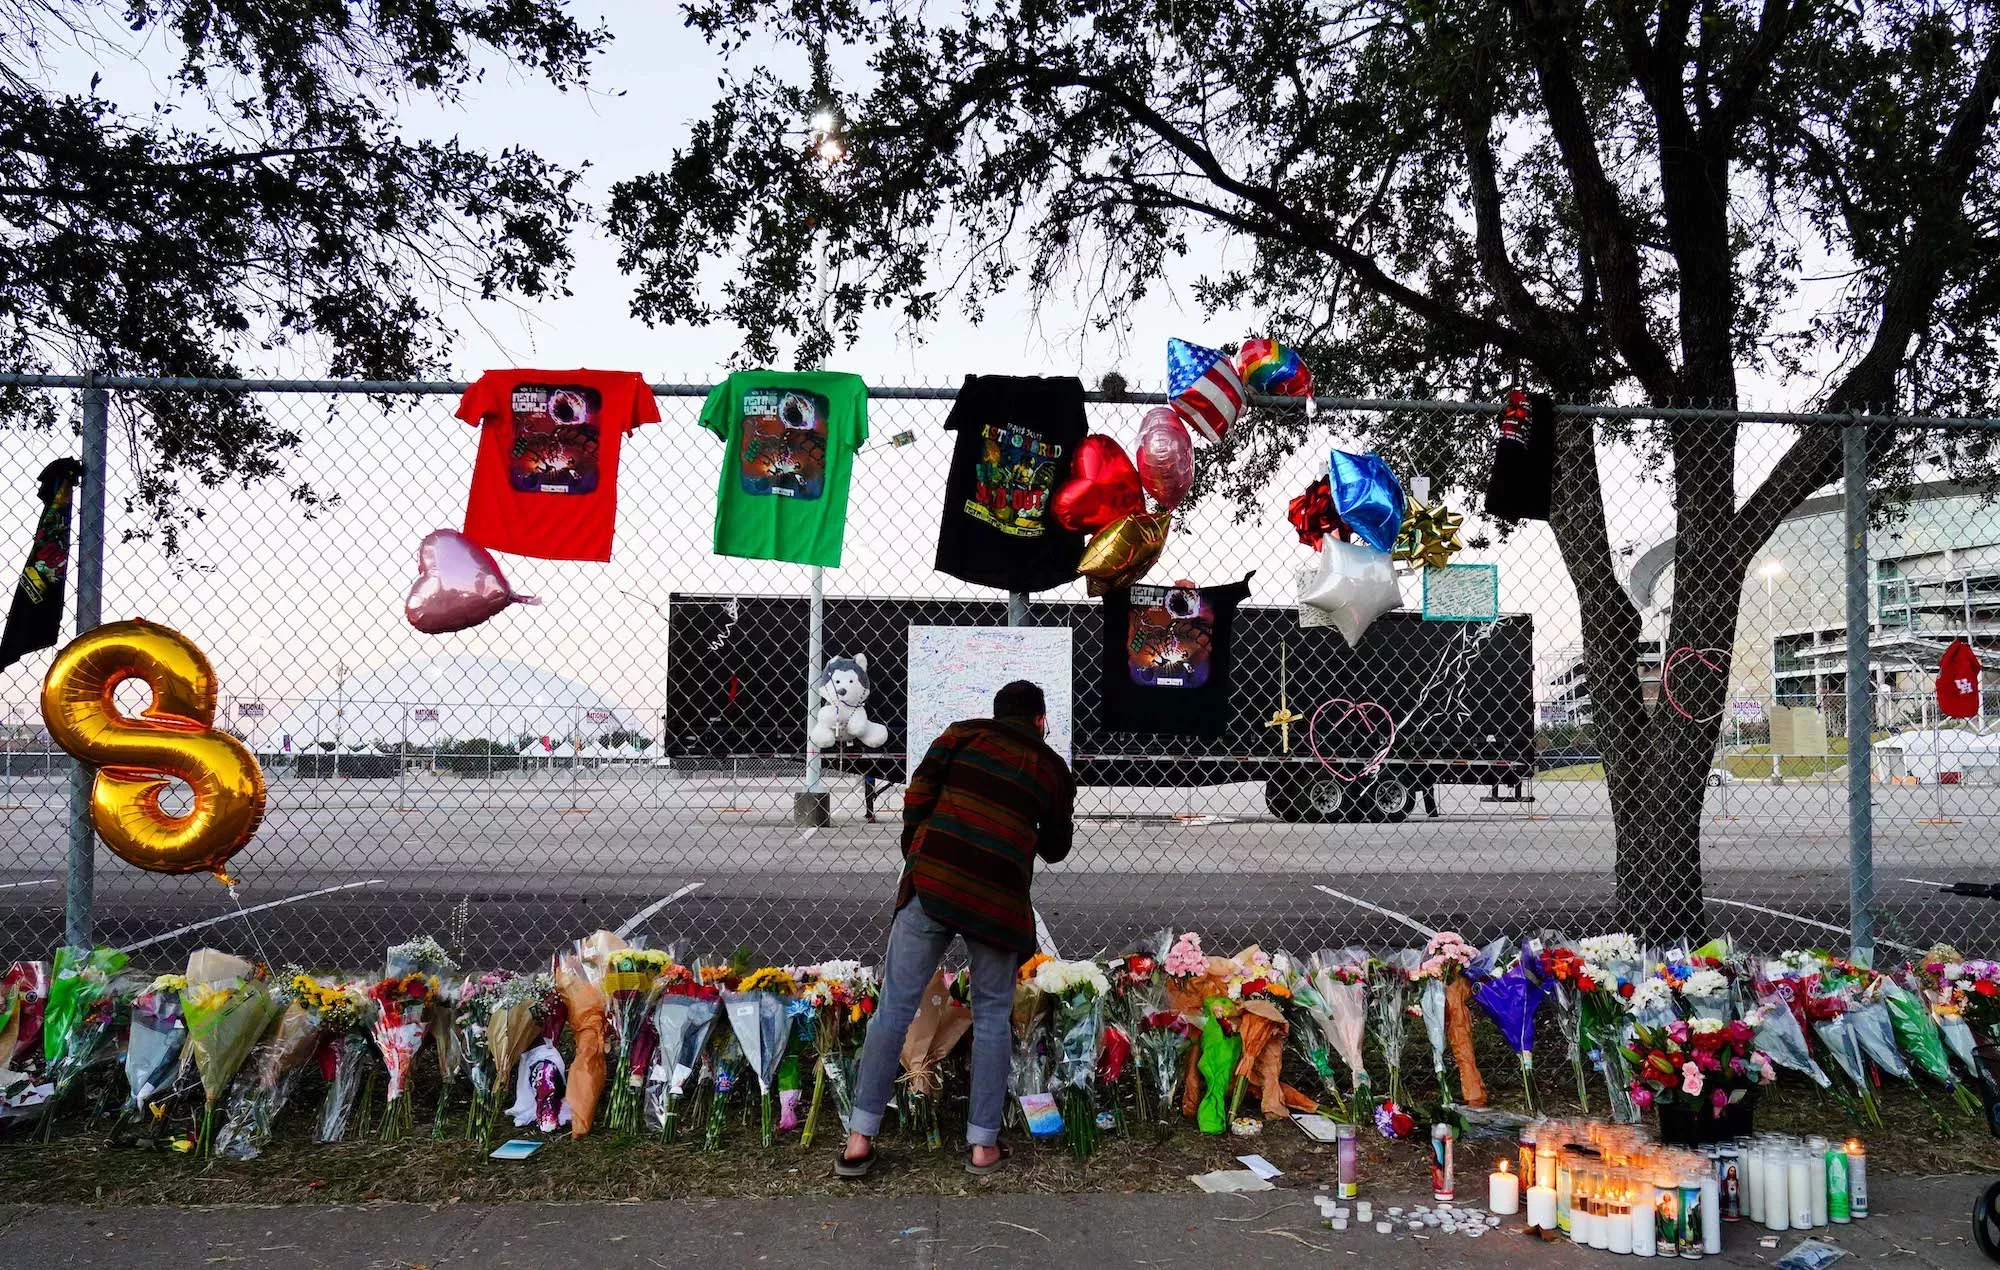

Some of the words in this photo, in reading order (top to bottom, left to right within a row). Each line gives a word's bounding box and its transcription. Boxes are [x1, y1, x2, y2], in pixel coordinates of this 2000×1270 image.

[511, 402, 547, 412] WORLD
[744, 405, 778, 415] WORLD
[981, 423, 1063, 459] ASTROWORLD
[1130, 595, 1164, 606] WORLD
[239, 703, 264, 711] NATIONAL
[1732, 701, 1761, 709] NATIONAL
[586, 711, 609, 720] NATIONAL
